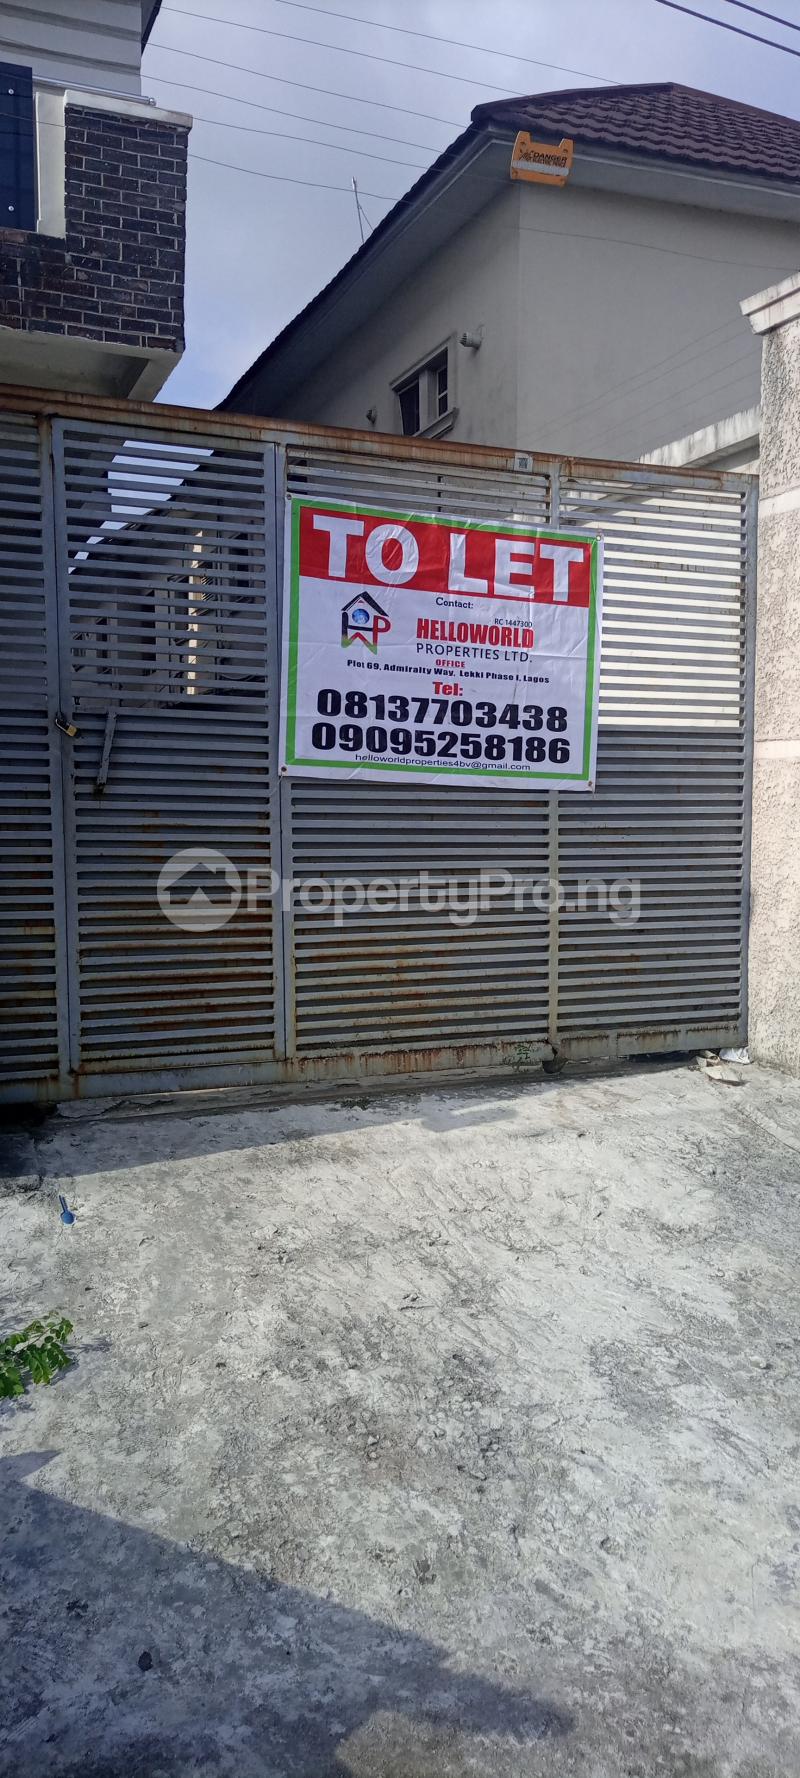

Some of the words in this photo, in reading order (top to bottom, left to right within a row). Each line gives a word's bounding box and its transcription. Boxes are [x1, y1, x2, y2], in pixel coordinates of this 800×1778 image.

[533, 151, 568, 161] DANGER
[312, 514, 420, 585] TO
[448, 532, 584, 602] LET
[435, 596, 474, 609] Contact:
[494, 618, 504, 626] RC
[505, 619, 533, 628] 1447300
[416, 618, 535, 649] HELLOWORLD
[416, 643, 500, 660] PROPERTIES
[504, 651, 533, 663] LTD.
[347, 659, 365, 668] Plot
[383, 664, 432, 675] Admiralty
[460, 670, 484, 679] Lekki
[486, 672, 514, 681] Phase
[523, 675, 550, 683] Lagos
[435, 659, 466, 668] OFFICE
[432, 681, 464, 696] Tel:
[317, 688, 568, 732] 08137703438
[311, 722, 570, 764] 09095258186
[355, 754, 531, 771] helloworldproperties4bv@gmail.com
